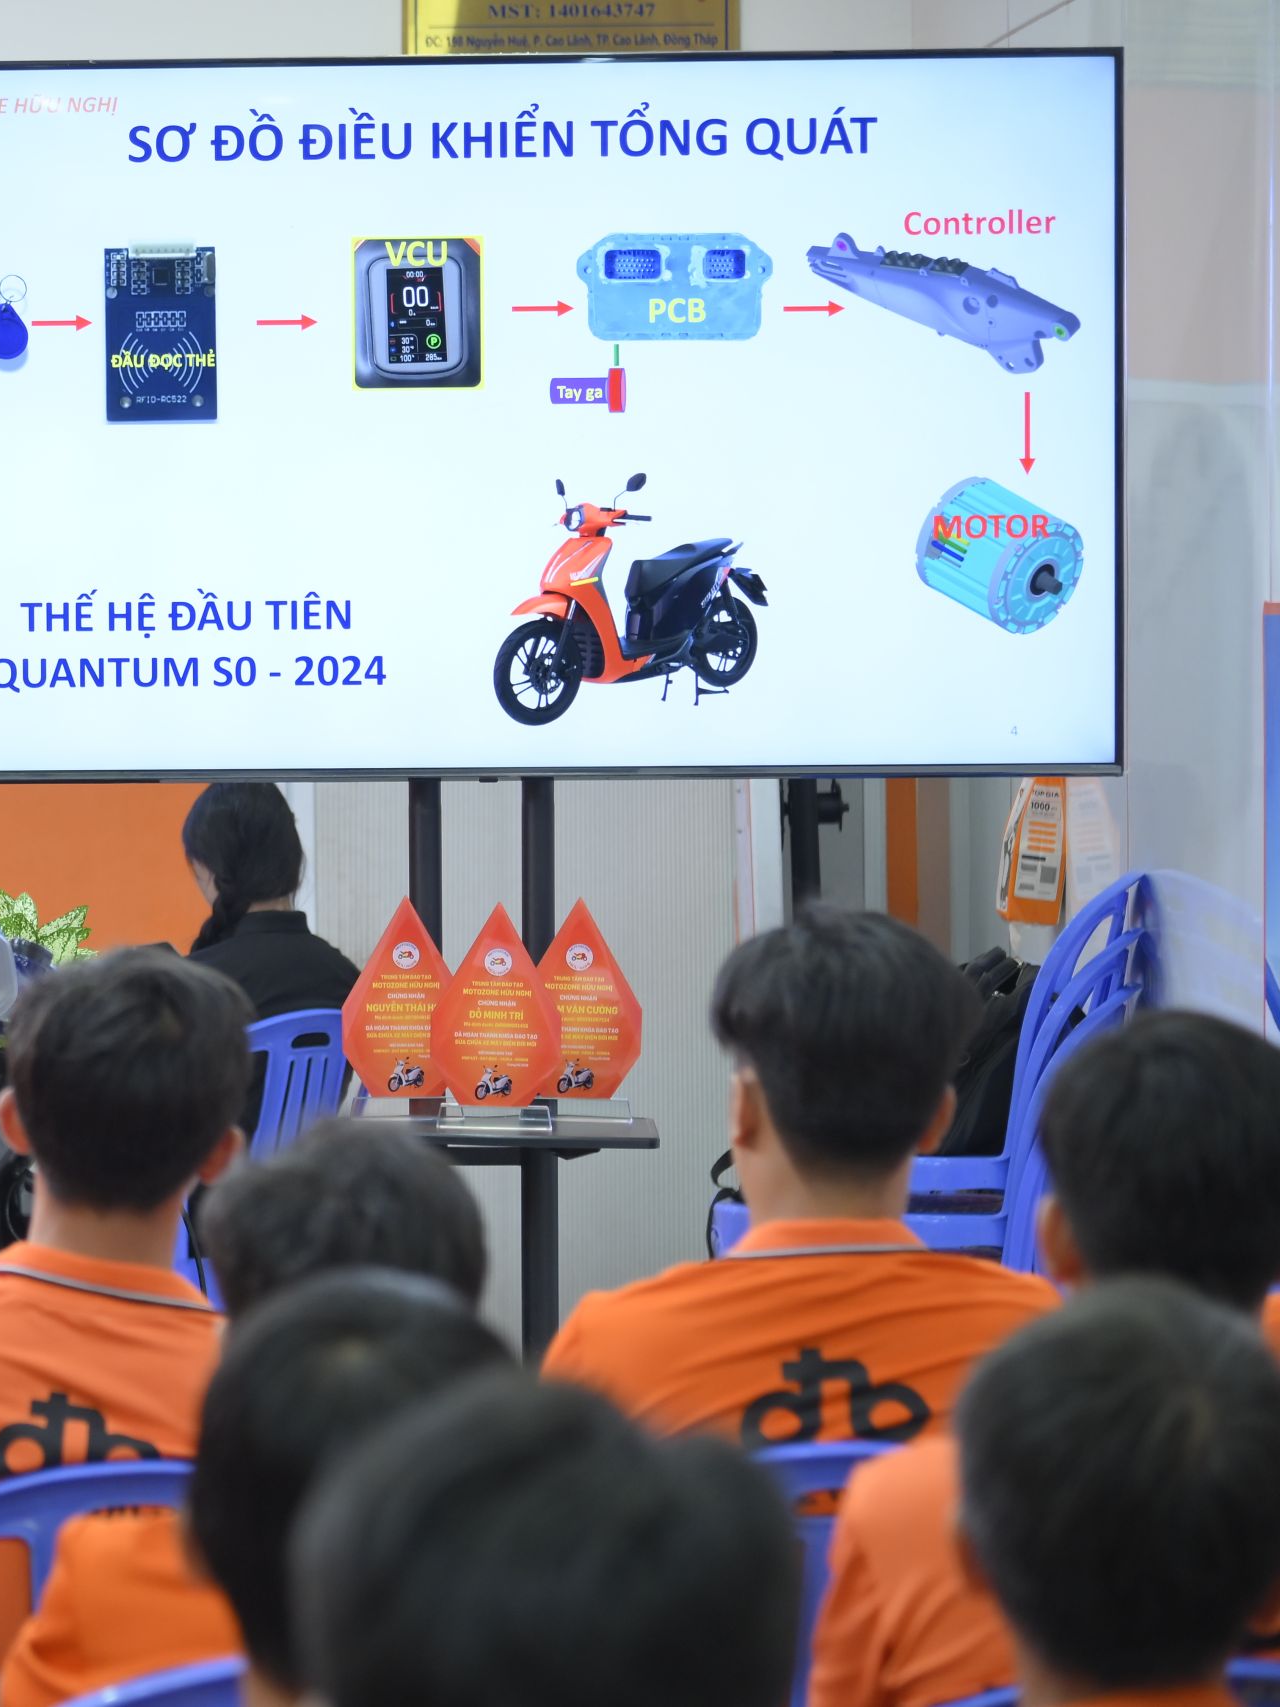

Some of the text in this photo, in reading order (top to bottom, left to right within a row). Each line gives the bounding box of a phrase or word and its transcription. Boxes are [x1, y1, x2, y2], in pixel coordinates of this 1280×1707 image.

[488, 3, 656, 18] MST: 1401643747
[546, 34, 565, 47] Cao
[613, 33, 631, 47] Cao
[694, 32, 719, 48] Tháp
[67, 96, 118, 117] NGHỊ
[128, 101, 878, 163] SƠ ĐỒ ĐIỀU KHIỂN TỔNG QUÁT
[904, 209, 1057, 236] Controller
[385, 240, 448, 267] VCU
[402, 286, 429, 308] 00
[648, 297, 706, 325] PCB
[111, 349, 216, 371] ĐẦU ĐỌC THẺ
[556, 385, 603, 403] Tay ga
[932, 513, 1051, 540] MOTOR
[19, 587, 352, 639] THẾ HỆ ĐẦU TIÊN
[213, 656, 257, 687] S0
[294, 656, 387, 686] 2024
[1010, 725, 1018, 736] 4
[1031, 801, 1050, 812] 1000
[372, 982, 408, 990] MOTOZONE
[463, 987, 500, 996] MOTOZONE
[545, 982, 581, 991] MOTOZONE
[483, 1010, 508, 1020] MINH
